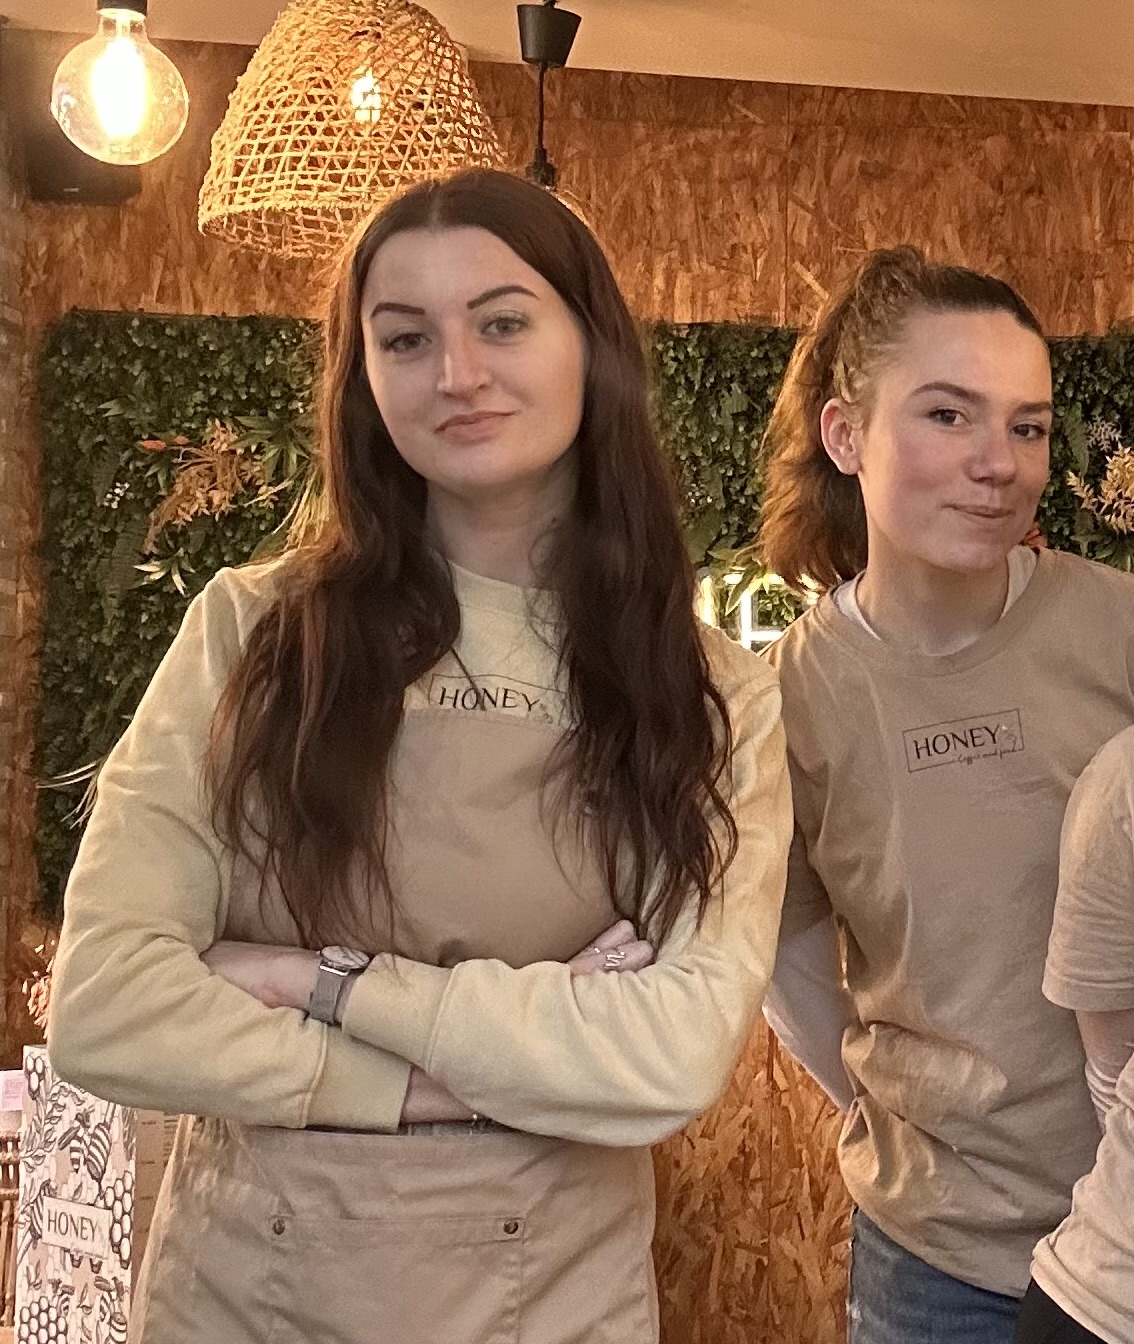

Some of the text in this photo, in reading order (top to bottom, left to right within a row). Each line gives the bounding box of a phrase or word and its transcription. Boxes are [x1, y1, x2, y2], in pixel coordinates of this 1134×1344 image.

[439, 686, 541, 712] HONEY
[913, 724, 1000, 759] HONEY
[47, 1209, 98, 1243] HONEY
